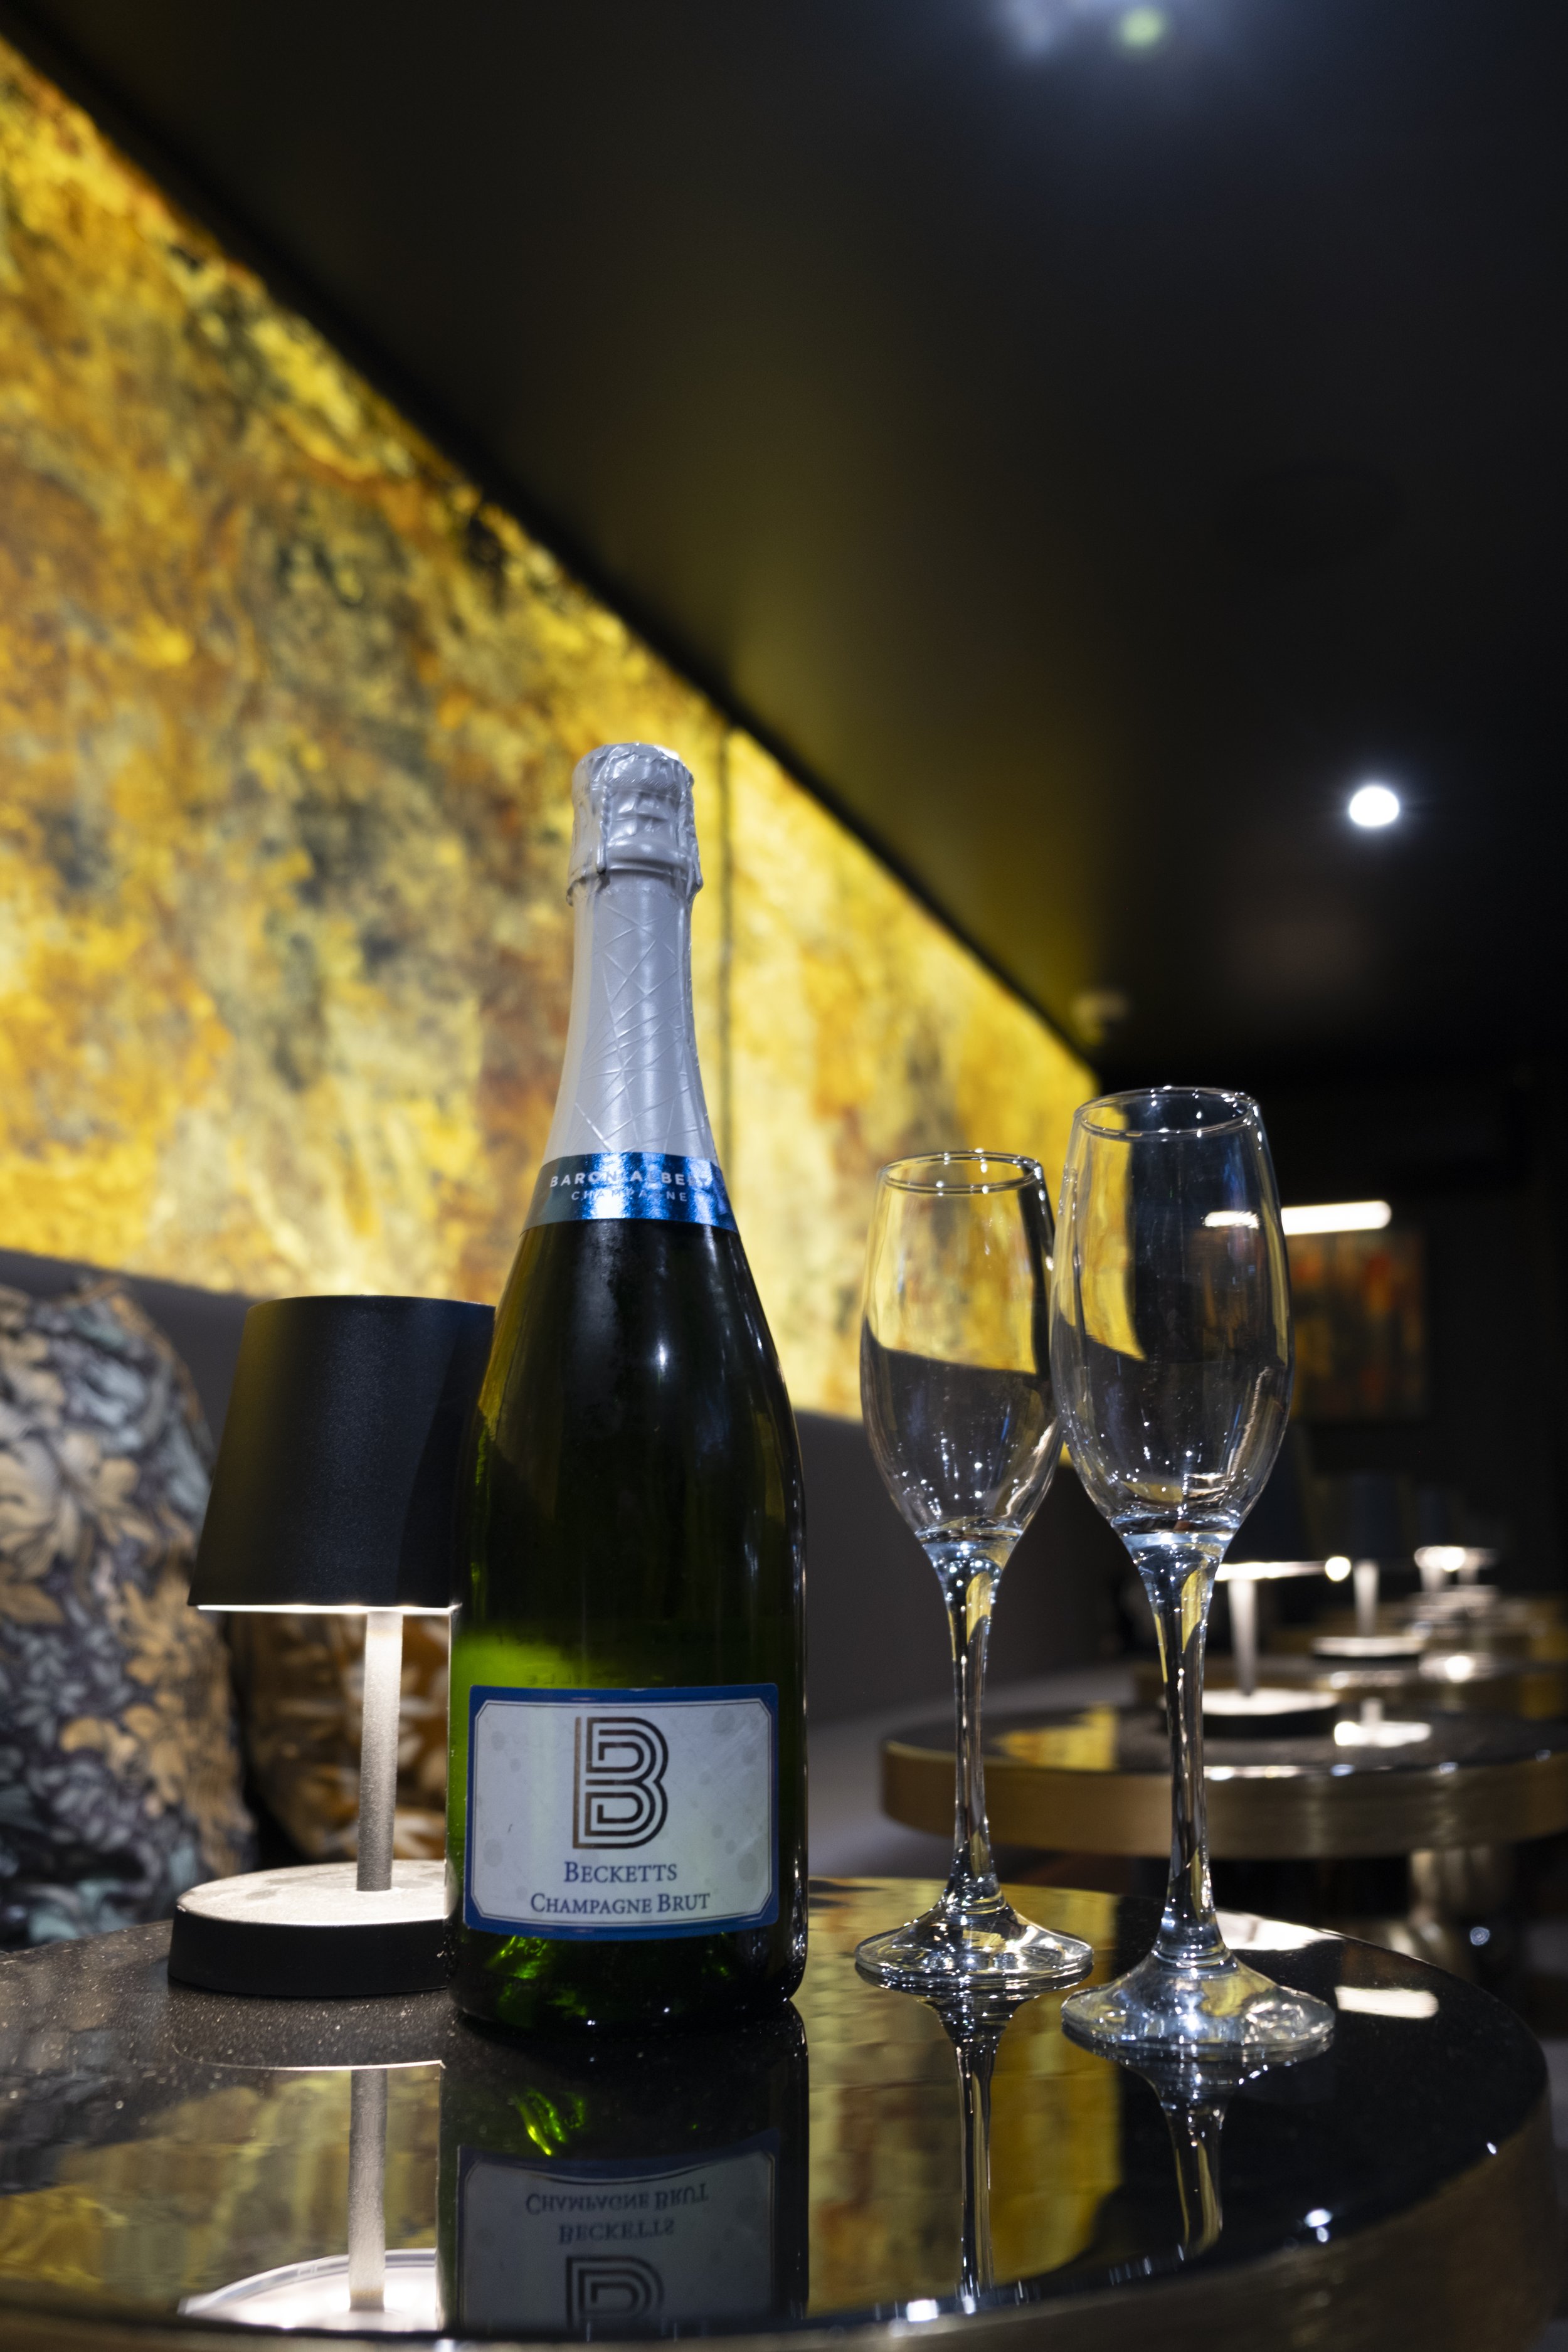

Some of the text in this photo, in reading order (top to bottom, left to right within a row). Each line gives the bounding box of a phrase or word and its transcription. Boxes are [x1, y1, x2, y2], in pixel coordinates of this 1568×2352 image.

[549, 1170, 617, 1188] BARON
[571, 1189, 687, 1202] CHAMPANE
[573, 1717, 669, 1849] B
[564, 1861, 677, 1882] BECKETTS
[531, 1892, 710, 1914] CHAMPAGNE BRUT
